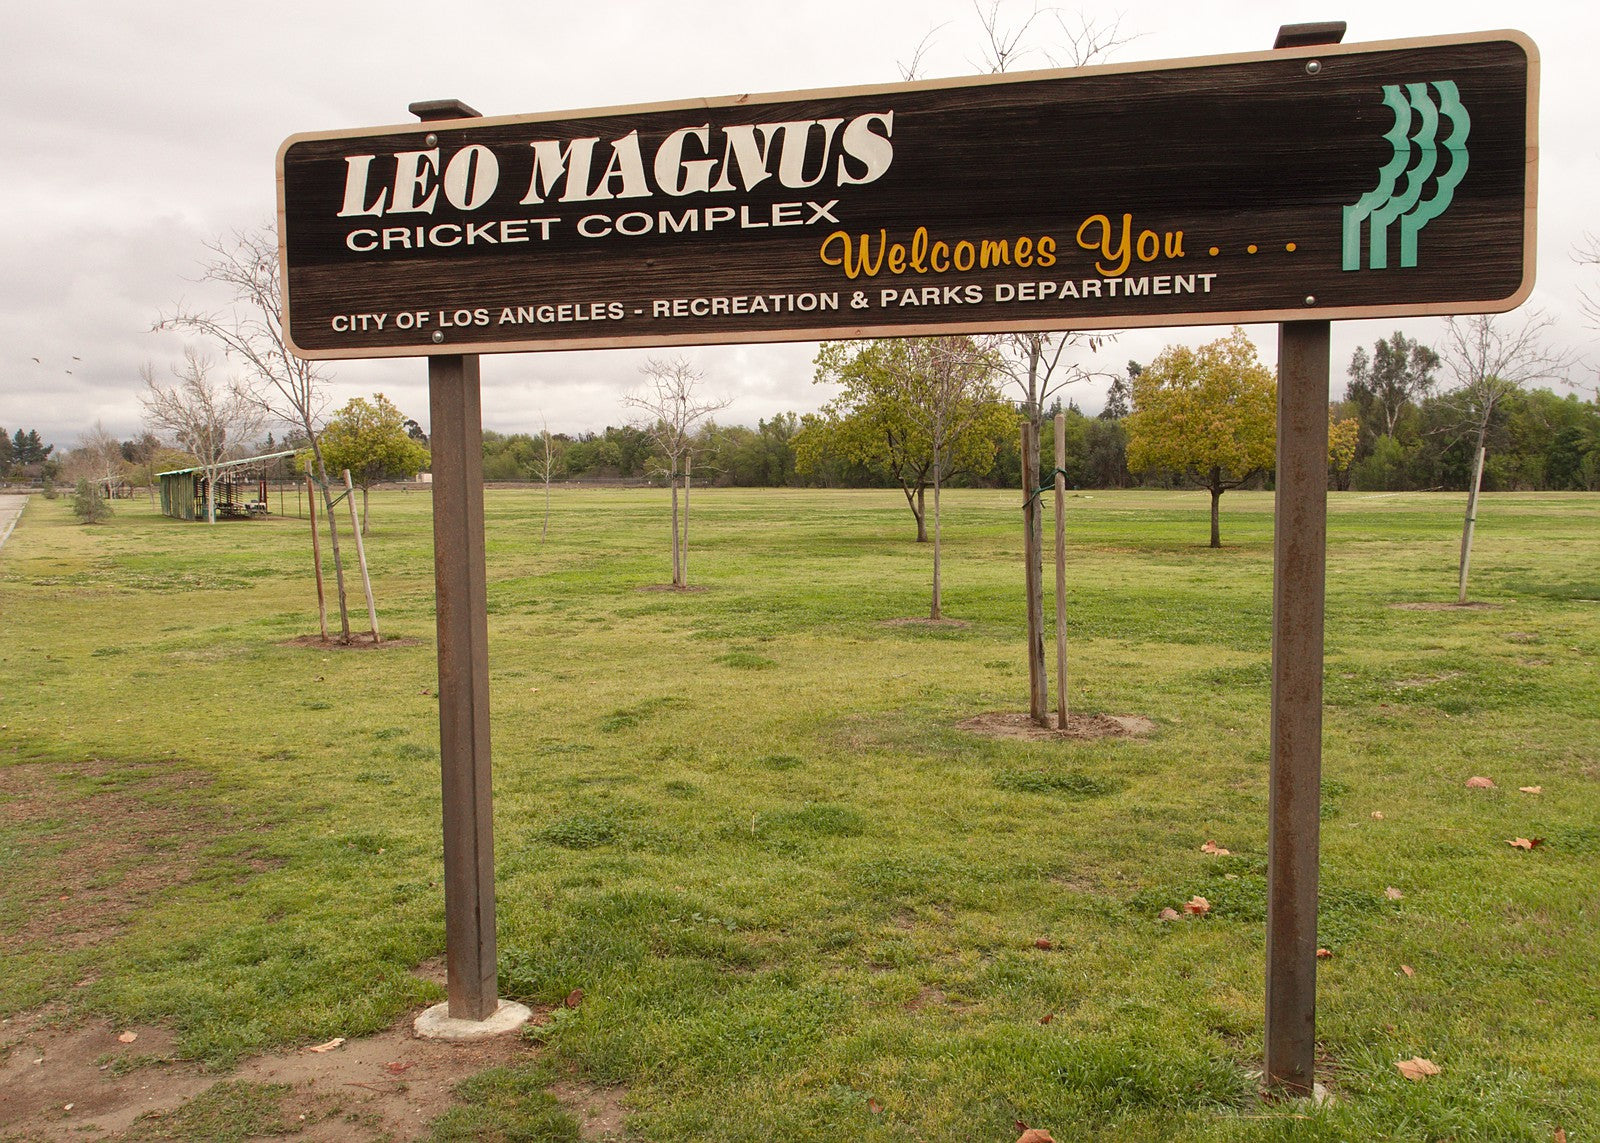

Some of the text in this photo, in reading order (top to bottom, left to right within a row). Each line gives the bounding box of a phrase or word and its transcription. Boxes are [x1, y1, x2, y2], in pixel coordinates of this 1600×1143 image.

[336, 110, 895, 218] LEO MAGNUS
[346, 200, 840, 252] CRICKET COMPLEX
[820, 226, 1057, 279] Welcomes
[1077, 213, 1185, 277] You
[331, 313, 388, 332] CITY
[395, 311, 430, 329] OF
[438, 308, 490, 327] LOS
[498, 301, 625, 325] ANGELES
[652, 292, 839, 318] RECREATION
[850, 290, 871, 309] &
[880, 284, 984, 308] PARKS
[995, 273, 1217, 302] DEPARTMENT
